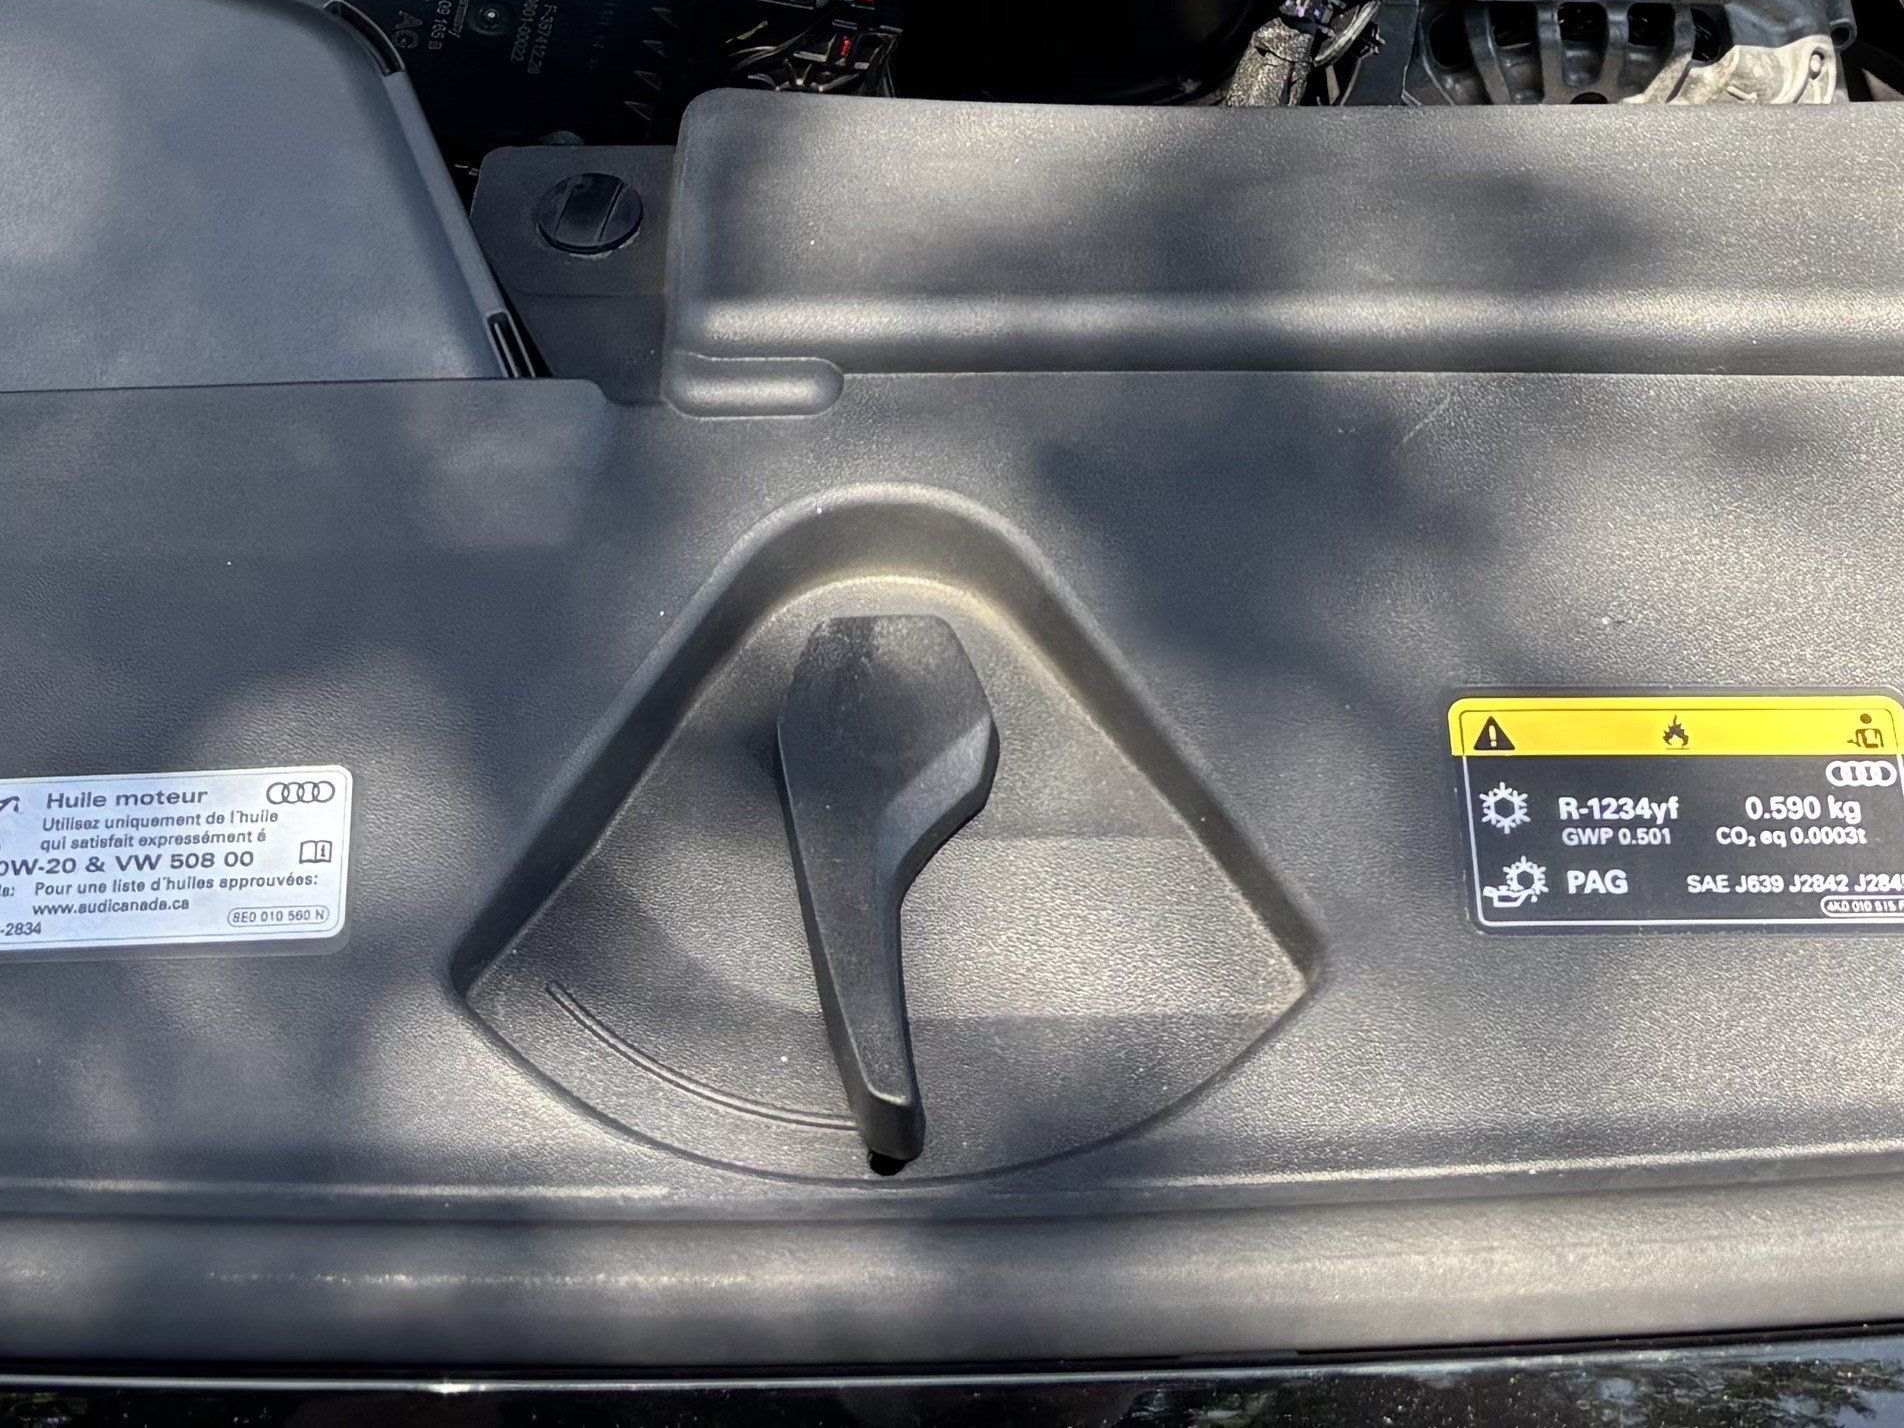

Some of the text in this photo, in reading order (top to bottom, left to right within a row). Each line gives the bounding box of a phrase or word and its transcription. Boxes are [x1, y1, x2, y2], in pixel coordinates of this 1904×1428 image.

[392, 10, 424, 49] AG
[46, 789, 208, 809] Huile moteur
[1559, 795, 1862, 824] R-1234yf 0.590 kg
[42, 816, 100, 832] Utilisez
[104, 813, 201, 830] uniquement
[205, 811, 225, 824] de
[40, 835, 66, 853] qui
[70, 833, 134, 849] satisfait
[138, 830, 252, 848] expressément
[1561, 828, 1671, 846] GWP 0.501
[1760, 831, 1787, 848] eq
[1791, 827, 1867, 845] 0.0003t
[84, 856, 105, 873] &
[115, 853, 162, 872] VW
[170, 852, 215, 869] 508
[223, 850, 254, 867] 00
[34, 882, 72, 895] Pour
[77, 882, 106, 894] une
[112, 879, 145, 892] liste
[218, 873, 318, 891] approuvées:
[1567, 870, 1628, 894] PAG
[1687, 875, 1728, 893] SAE
[1735, 874, 1784, 893] J639
[1789, 874, 1849, 893] J2842
[32, 897, 189, 916] www.audicanada.ca
[232, 911, 256, 923] 8E0
[260, 910, 283, 922] 010
[315, 909, 325, 920] N
